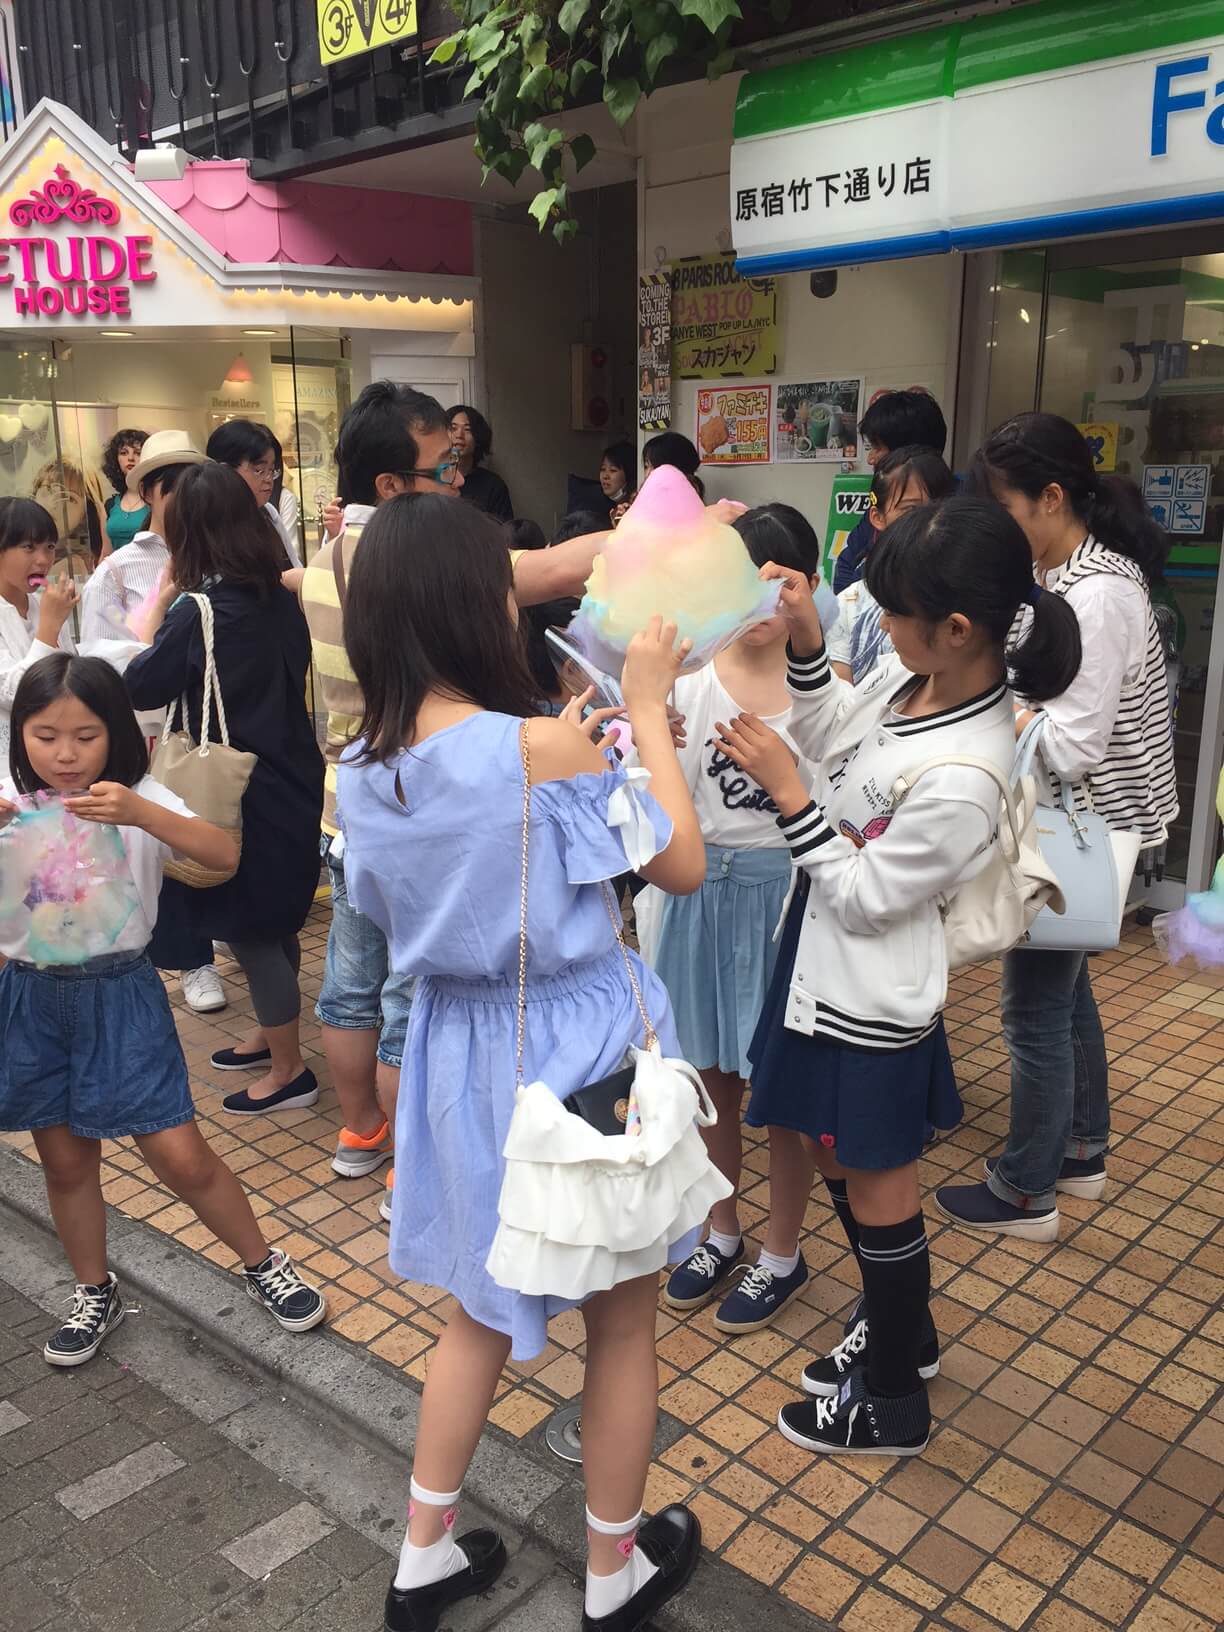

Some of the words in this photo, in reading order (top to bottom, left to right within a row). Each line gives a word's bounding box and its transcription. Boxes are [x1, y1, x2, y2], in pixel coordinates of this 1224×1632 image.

[736, 157, 931, 221] 原宿竹下通り店
[14, 286, 131, 315] HOUSE
[652, 325, 671, 345] 3F
[695, 323, 718, 338] WEST
[691, 344, 756, 368] スカジャン
[211, 397, 260, 409] Bestsellers
[717, 391, 768, 416] ファミチキ
